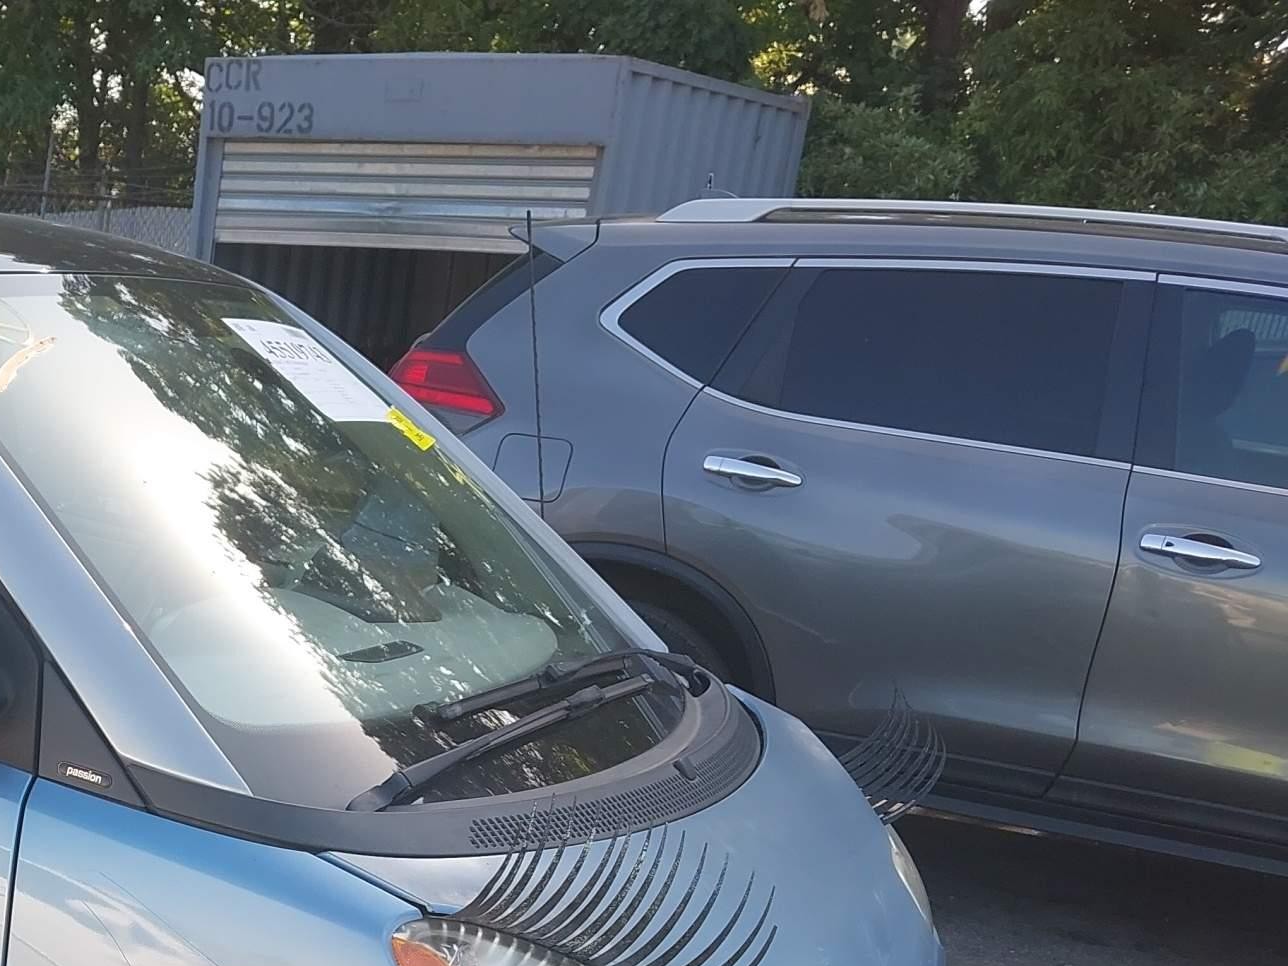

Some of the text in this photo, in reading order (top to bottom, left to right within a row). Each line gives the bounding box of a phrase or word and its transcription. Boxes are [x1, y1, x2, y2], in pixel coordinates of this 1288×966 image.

[206, 60, 262, 92] CCR
[209, 100, 314, 133] 10-923
[66, 766, 102, 784] passion
